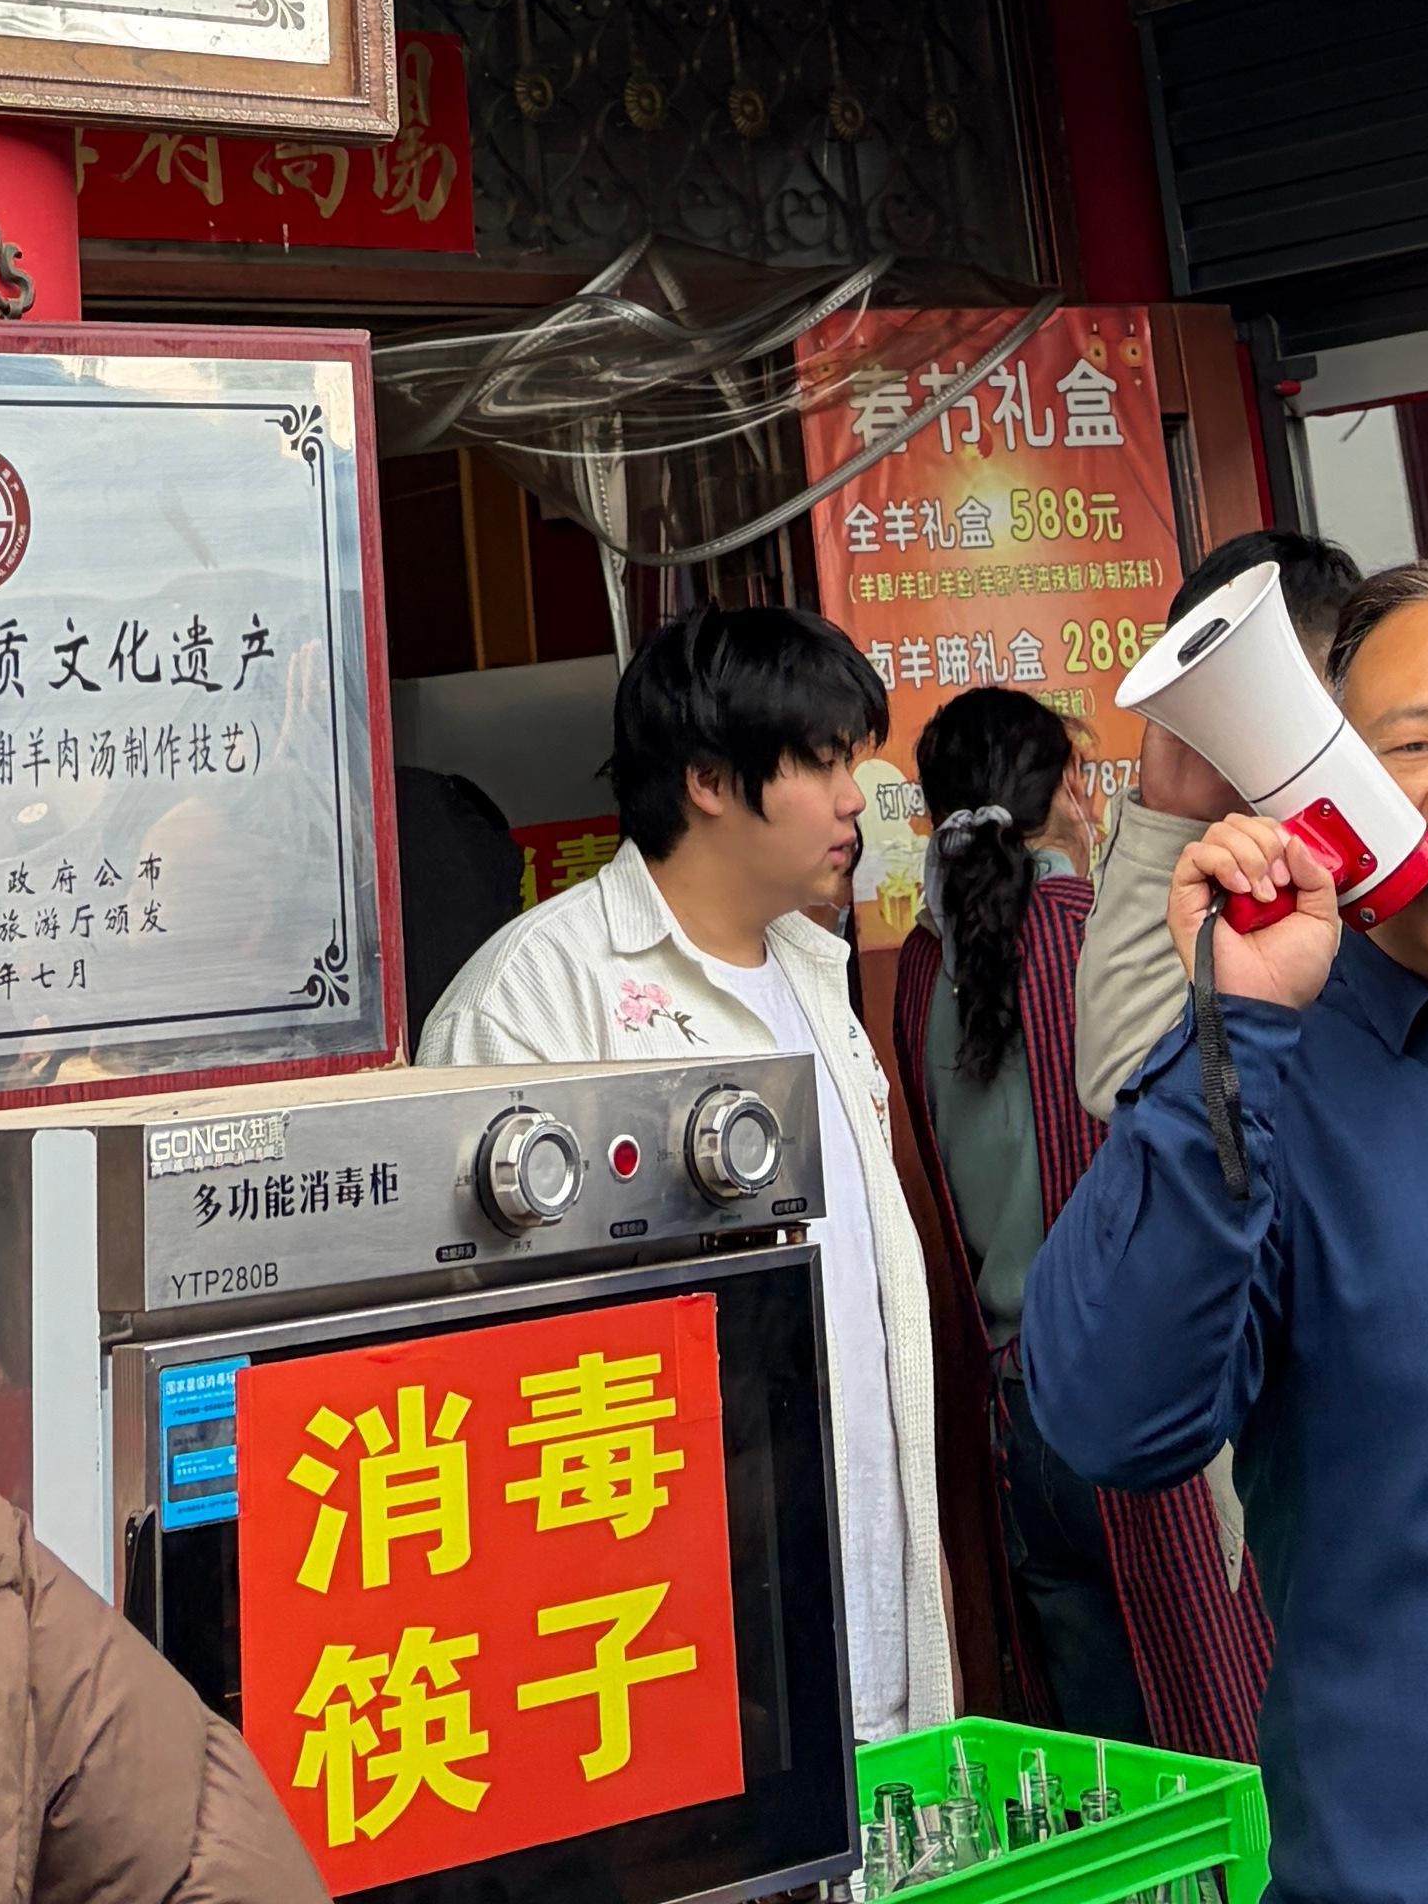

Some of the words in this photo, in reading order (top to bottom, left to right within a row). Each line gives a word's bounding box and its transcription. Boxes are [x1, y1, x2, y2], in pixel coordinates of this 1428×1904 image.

[849, 356, 1126, 454] 春节礼盒
[843, 496, 994, 554] 全羊礼盒
[1010, 487, 1124, 543] 588元
[1080, 758, 1141, 799] 787
[520, 833, 621, 912] 毒
[192, 1162, 400, 1229] 多功能消毒柜
[171, 1261, 280, 1299] YTP280B
[286, 1349, 686, 1594] 消毒
[292, 1578, 699, 1848] 筷子
